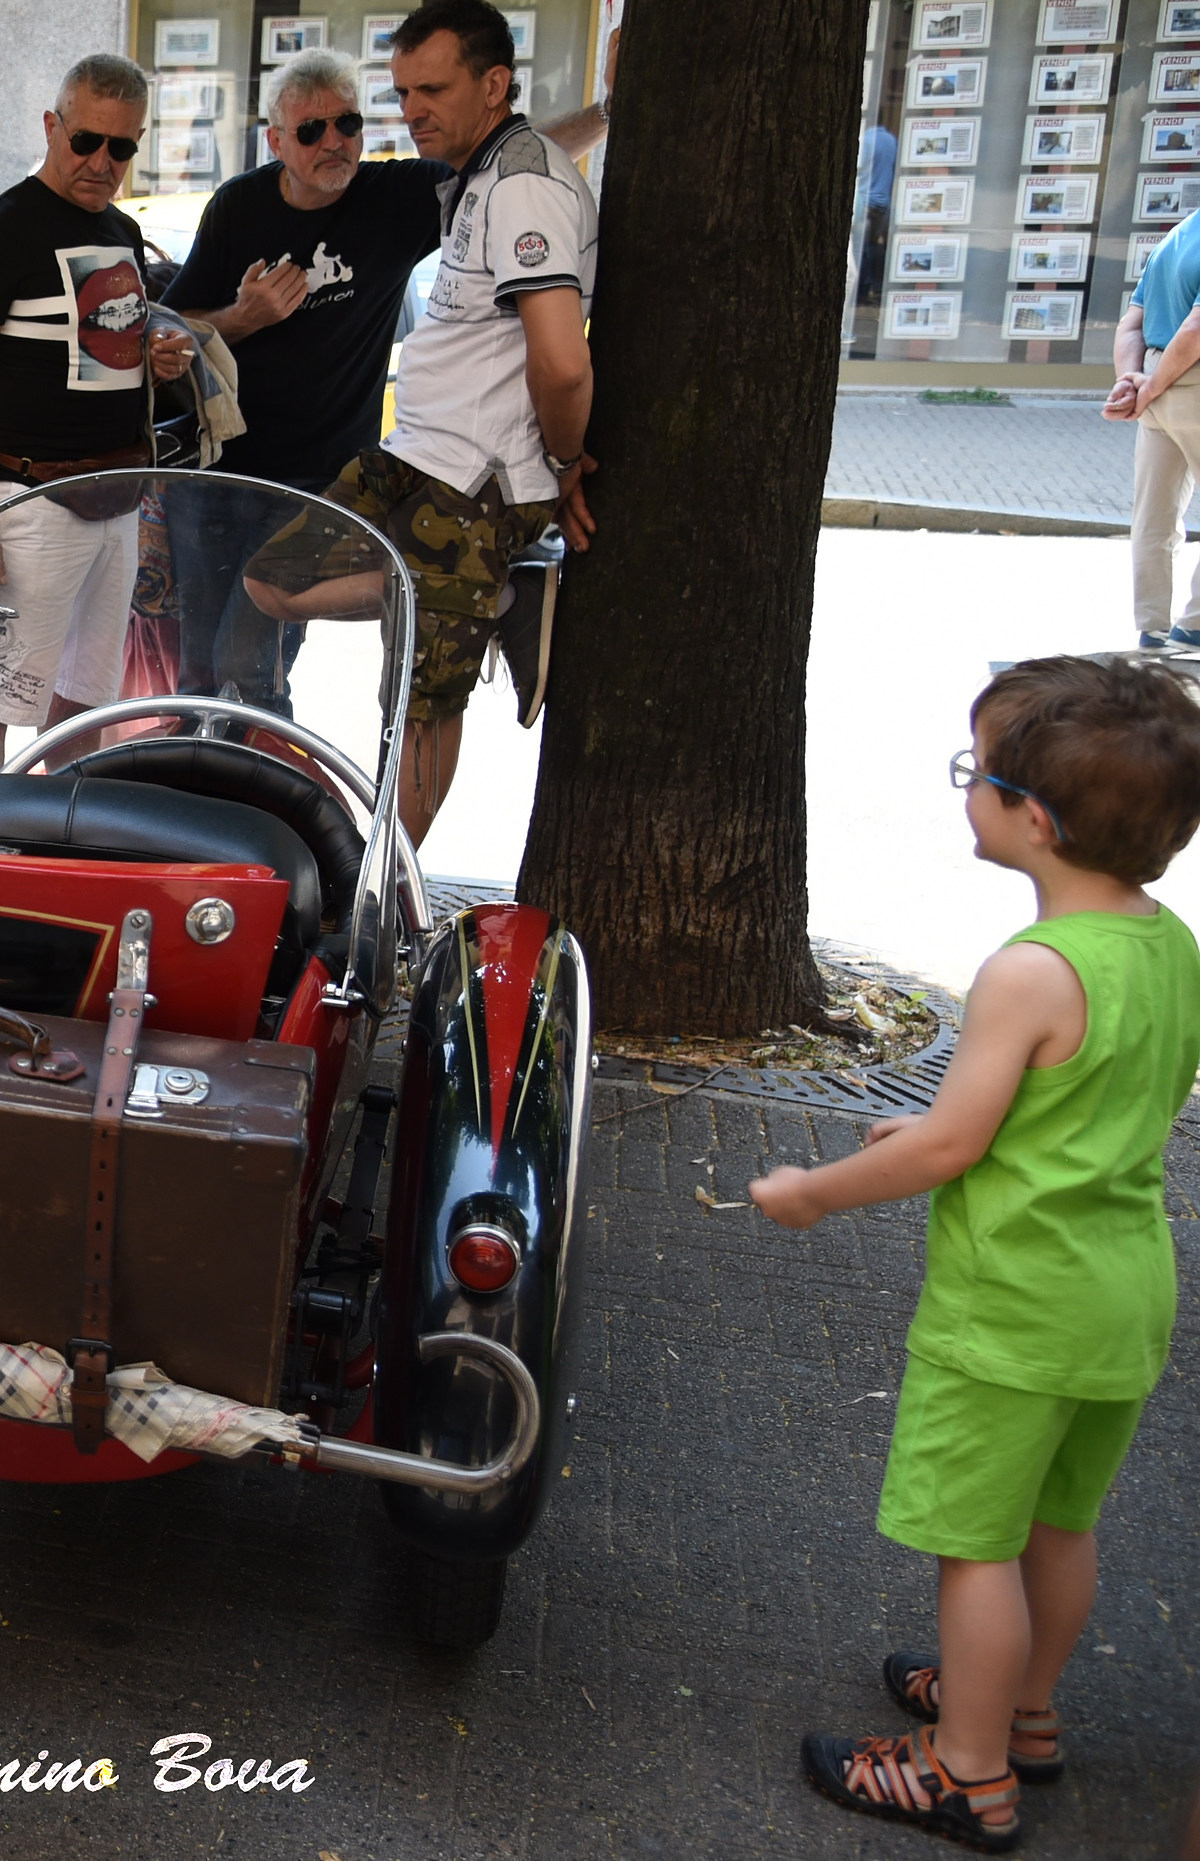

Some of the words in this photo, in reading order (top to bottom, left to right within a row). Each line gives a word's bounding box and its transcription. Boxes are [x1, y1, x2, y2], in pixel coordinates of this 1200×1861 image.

[1040, 59, 1069, 67] VENDE
[1160, 57, 1191, 65] VENDE
[1153, 118, 1184, 126] VENDE
[1145, 177, 1174, 185] VENDE
